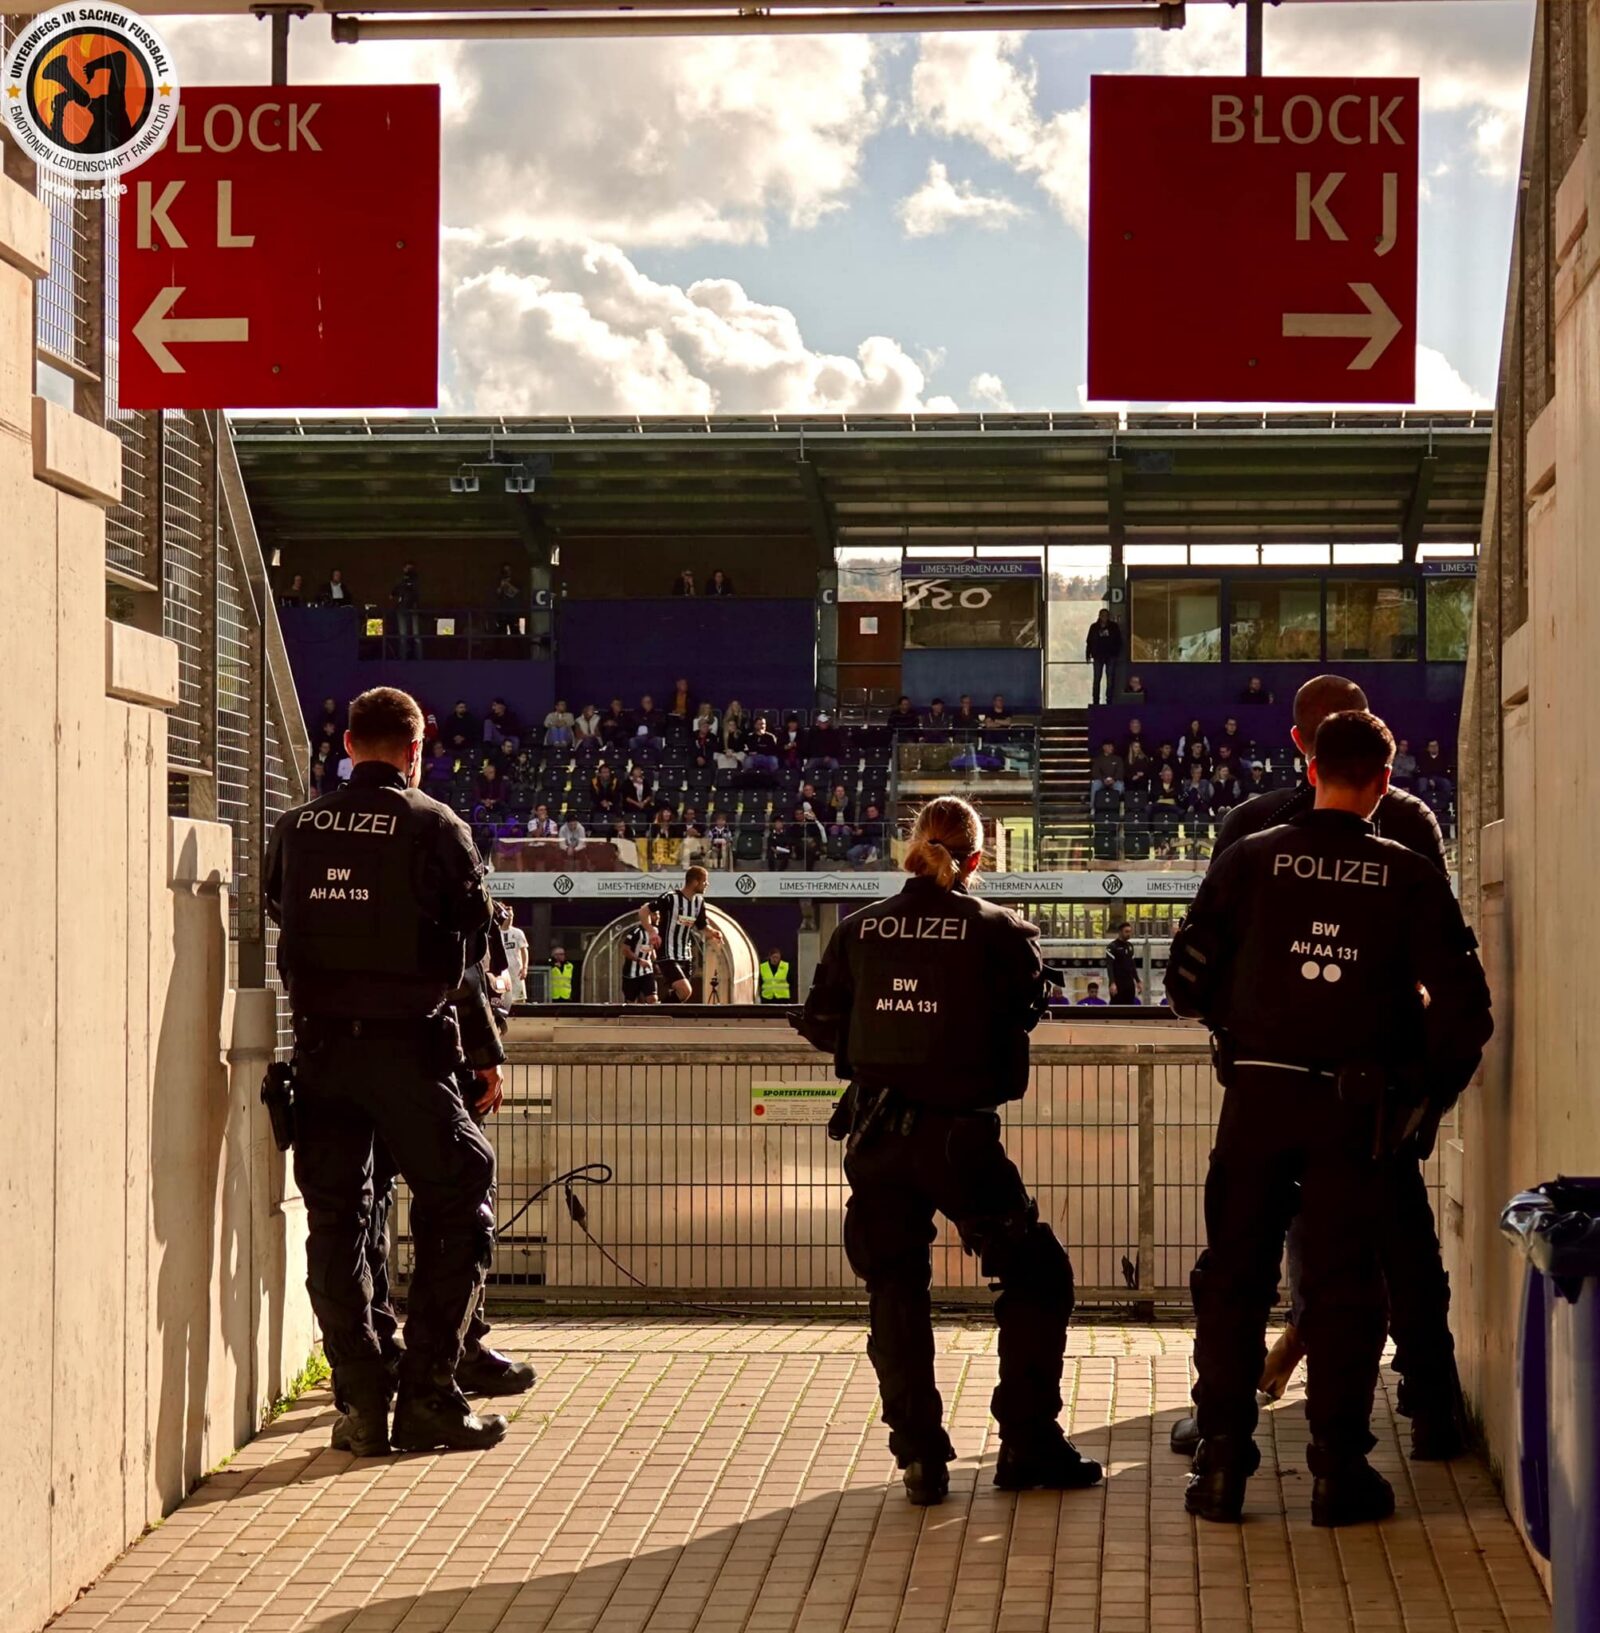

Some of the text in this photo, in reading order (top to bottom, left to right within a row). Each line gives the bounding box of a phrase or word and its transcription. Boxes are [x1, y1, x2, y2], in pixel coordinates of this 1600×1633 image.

[1211, 95, 1405, 144] BLOCK
[163, 103, 323, 153] LOCK
[137, 180, 255, 248] K L
[1296, 172, 1398, 257] K J
[920, 564, 1022, 573] LIMES-THERMEN AALEN
[536, 590, 547, 605] C
[822, 589, 833, 604] C
[1111, 588, 1123, 603] D
[296, 810, 397, 835] POLIZEI
[327, 868, 351, 881] BW
[1273, 853, 1388, 887] POLIZEI
[597, 882, 666, 891] LIMES-THERMEN
[779, 882, 880, 891] LIMES-THERMEN AALEN
[1033, 882, 1064, 891] AALEN
[1146, 882, 1200, 891] LIMES-THER
[309, 888, 370, 901] AH AA 133
[860, 916, 968, 940] POLIZEI
[1312, 921, 1340, 937] BW
[1290, 940, 1359, 961] AH AA 131
[893, 978, 919, 992] BW
[876, 998, 938, 1014] AH AA 131
[763, 1089, 838, 1097] SPORTSTÄTTENBAU
